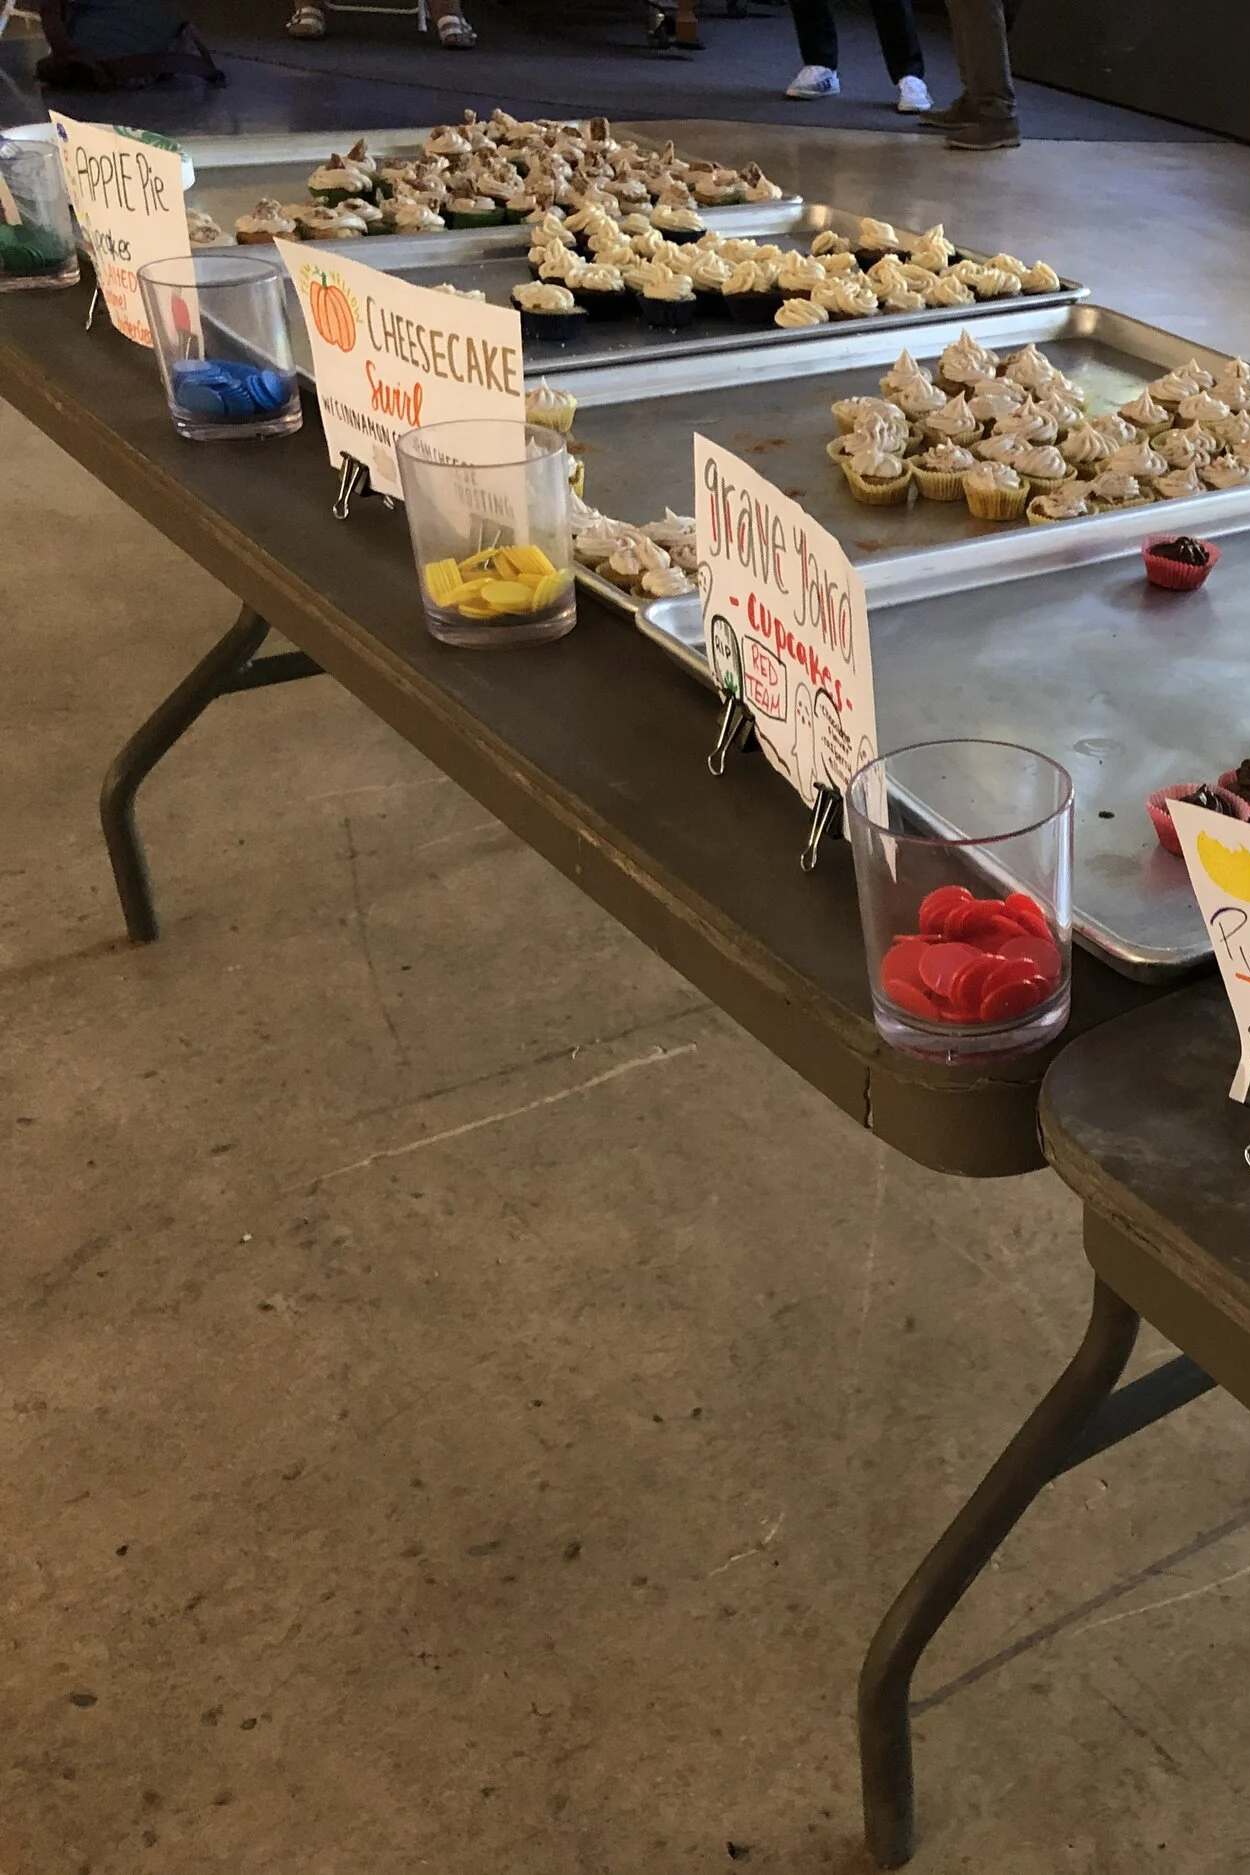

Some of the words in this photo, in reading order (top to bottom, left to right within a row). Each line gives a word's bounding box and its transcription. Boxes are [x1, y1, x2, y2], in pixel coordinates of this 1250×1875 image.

[366, 295, 521, 397] CHEESECAKE
[366, 359, 423, 428] Swirl
[715, 635, 731, 659] RIP
[751, 642, 778, 686] RED
[744, 671, 780, 719] TEAM
